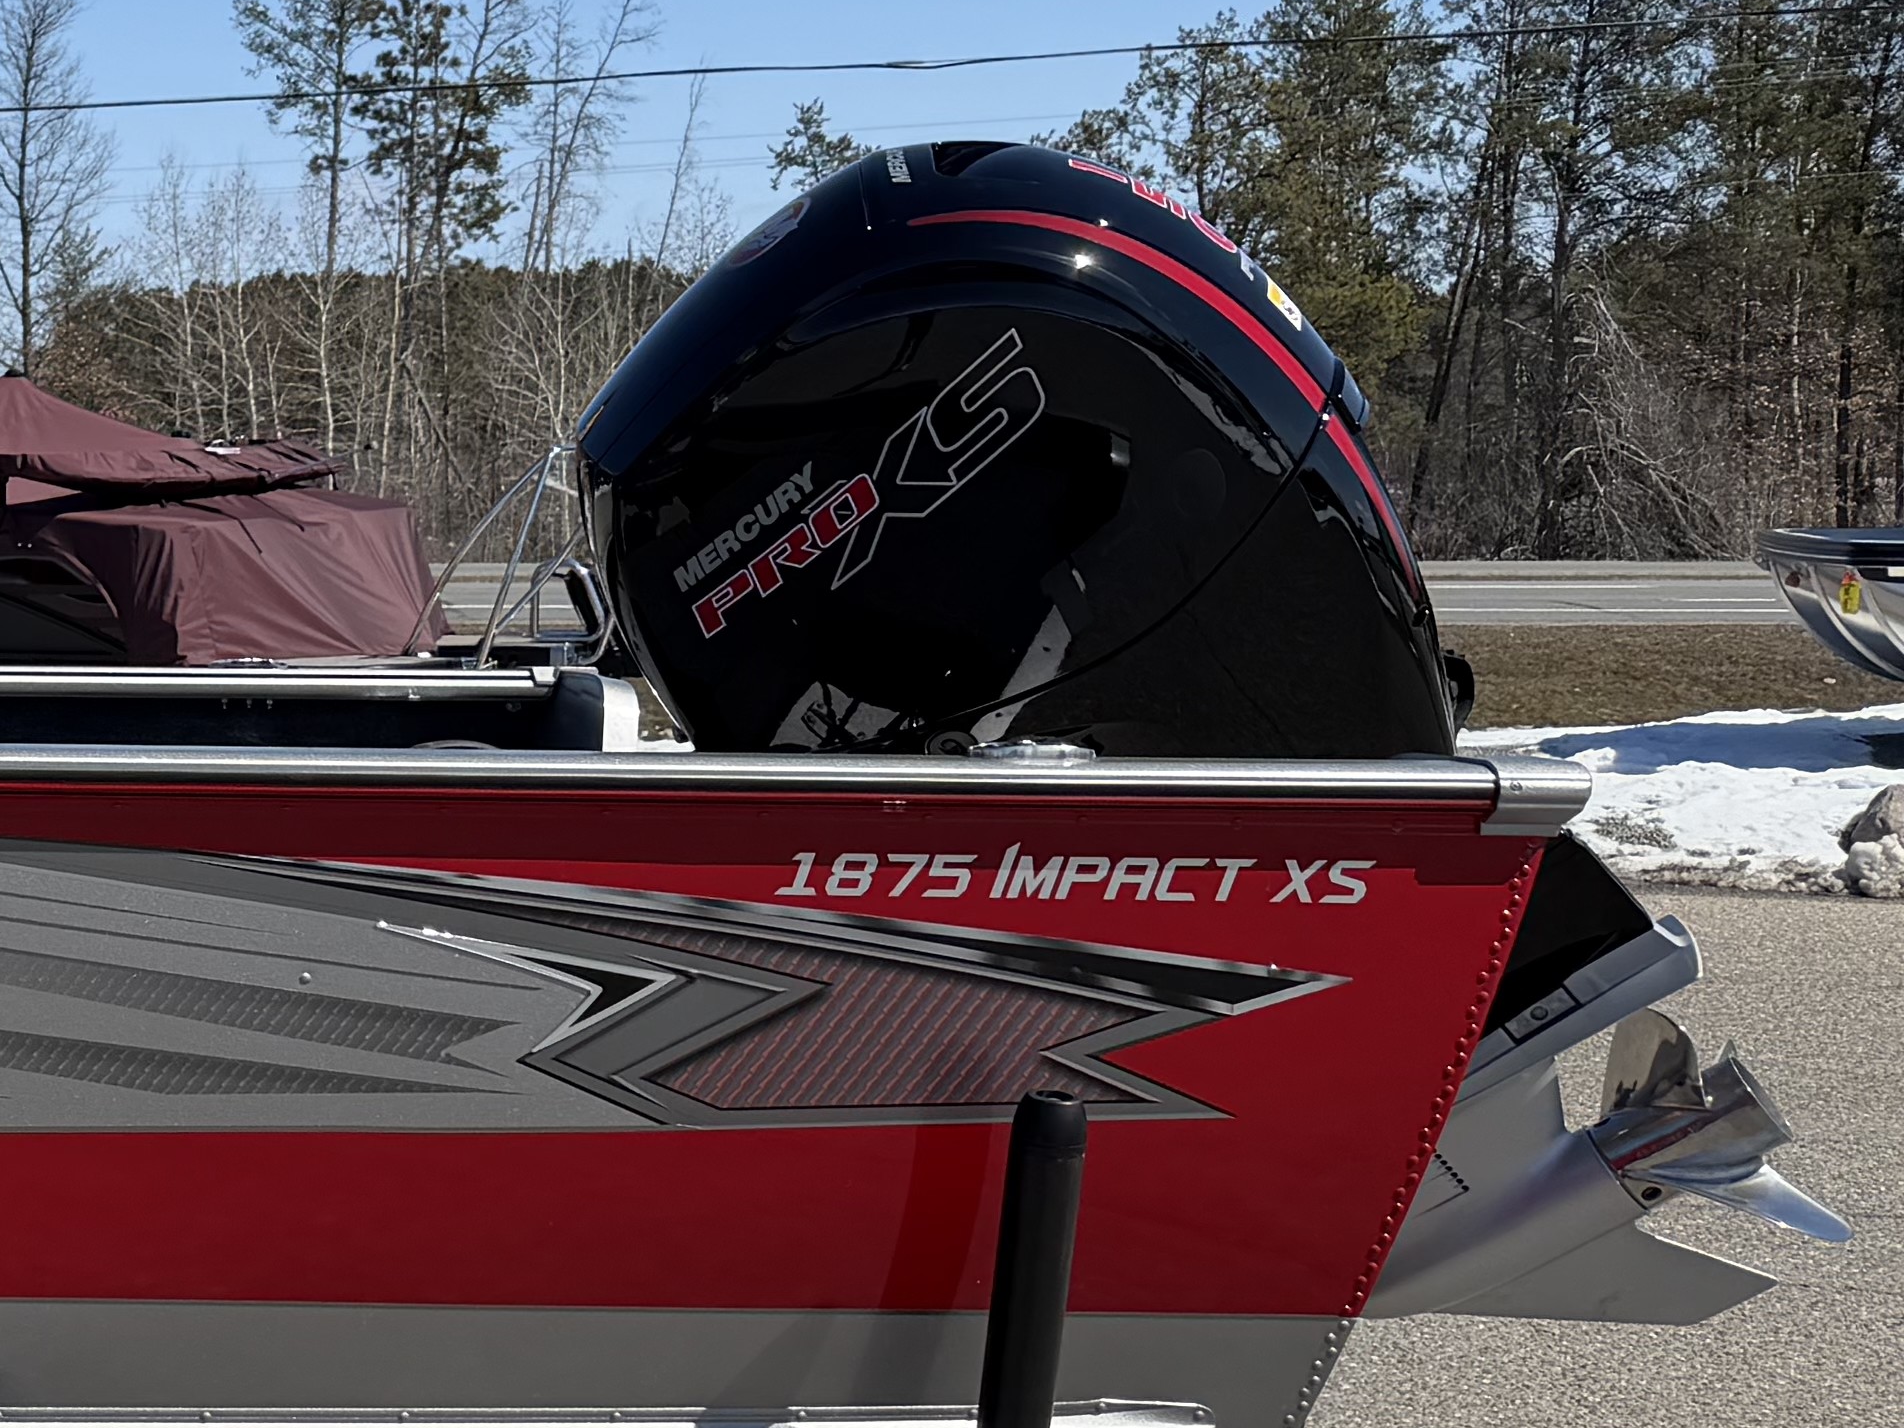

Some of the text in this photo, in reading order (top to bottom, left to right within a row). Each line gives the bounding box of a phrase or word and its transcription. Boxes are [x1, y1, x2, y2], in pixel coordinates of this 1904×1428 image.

[672, 460, 817, 593] MERCURY
[692, 327, 1046, 639] PRO XS
[774, 842, 1378, 905] 1875 IMPACT XS
